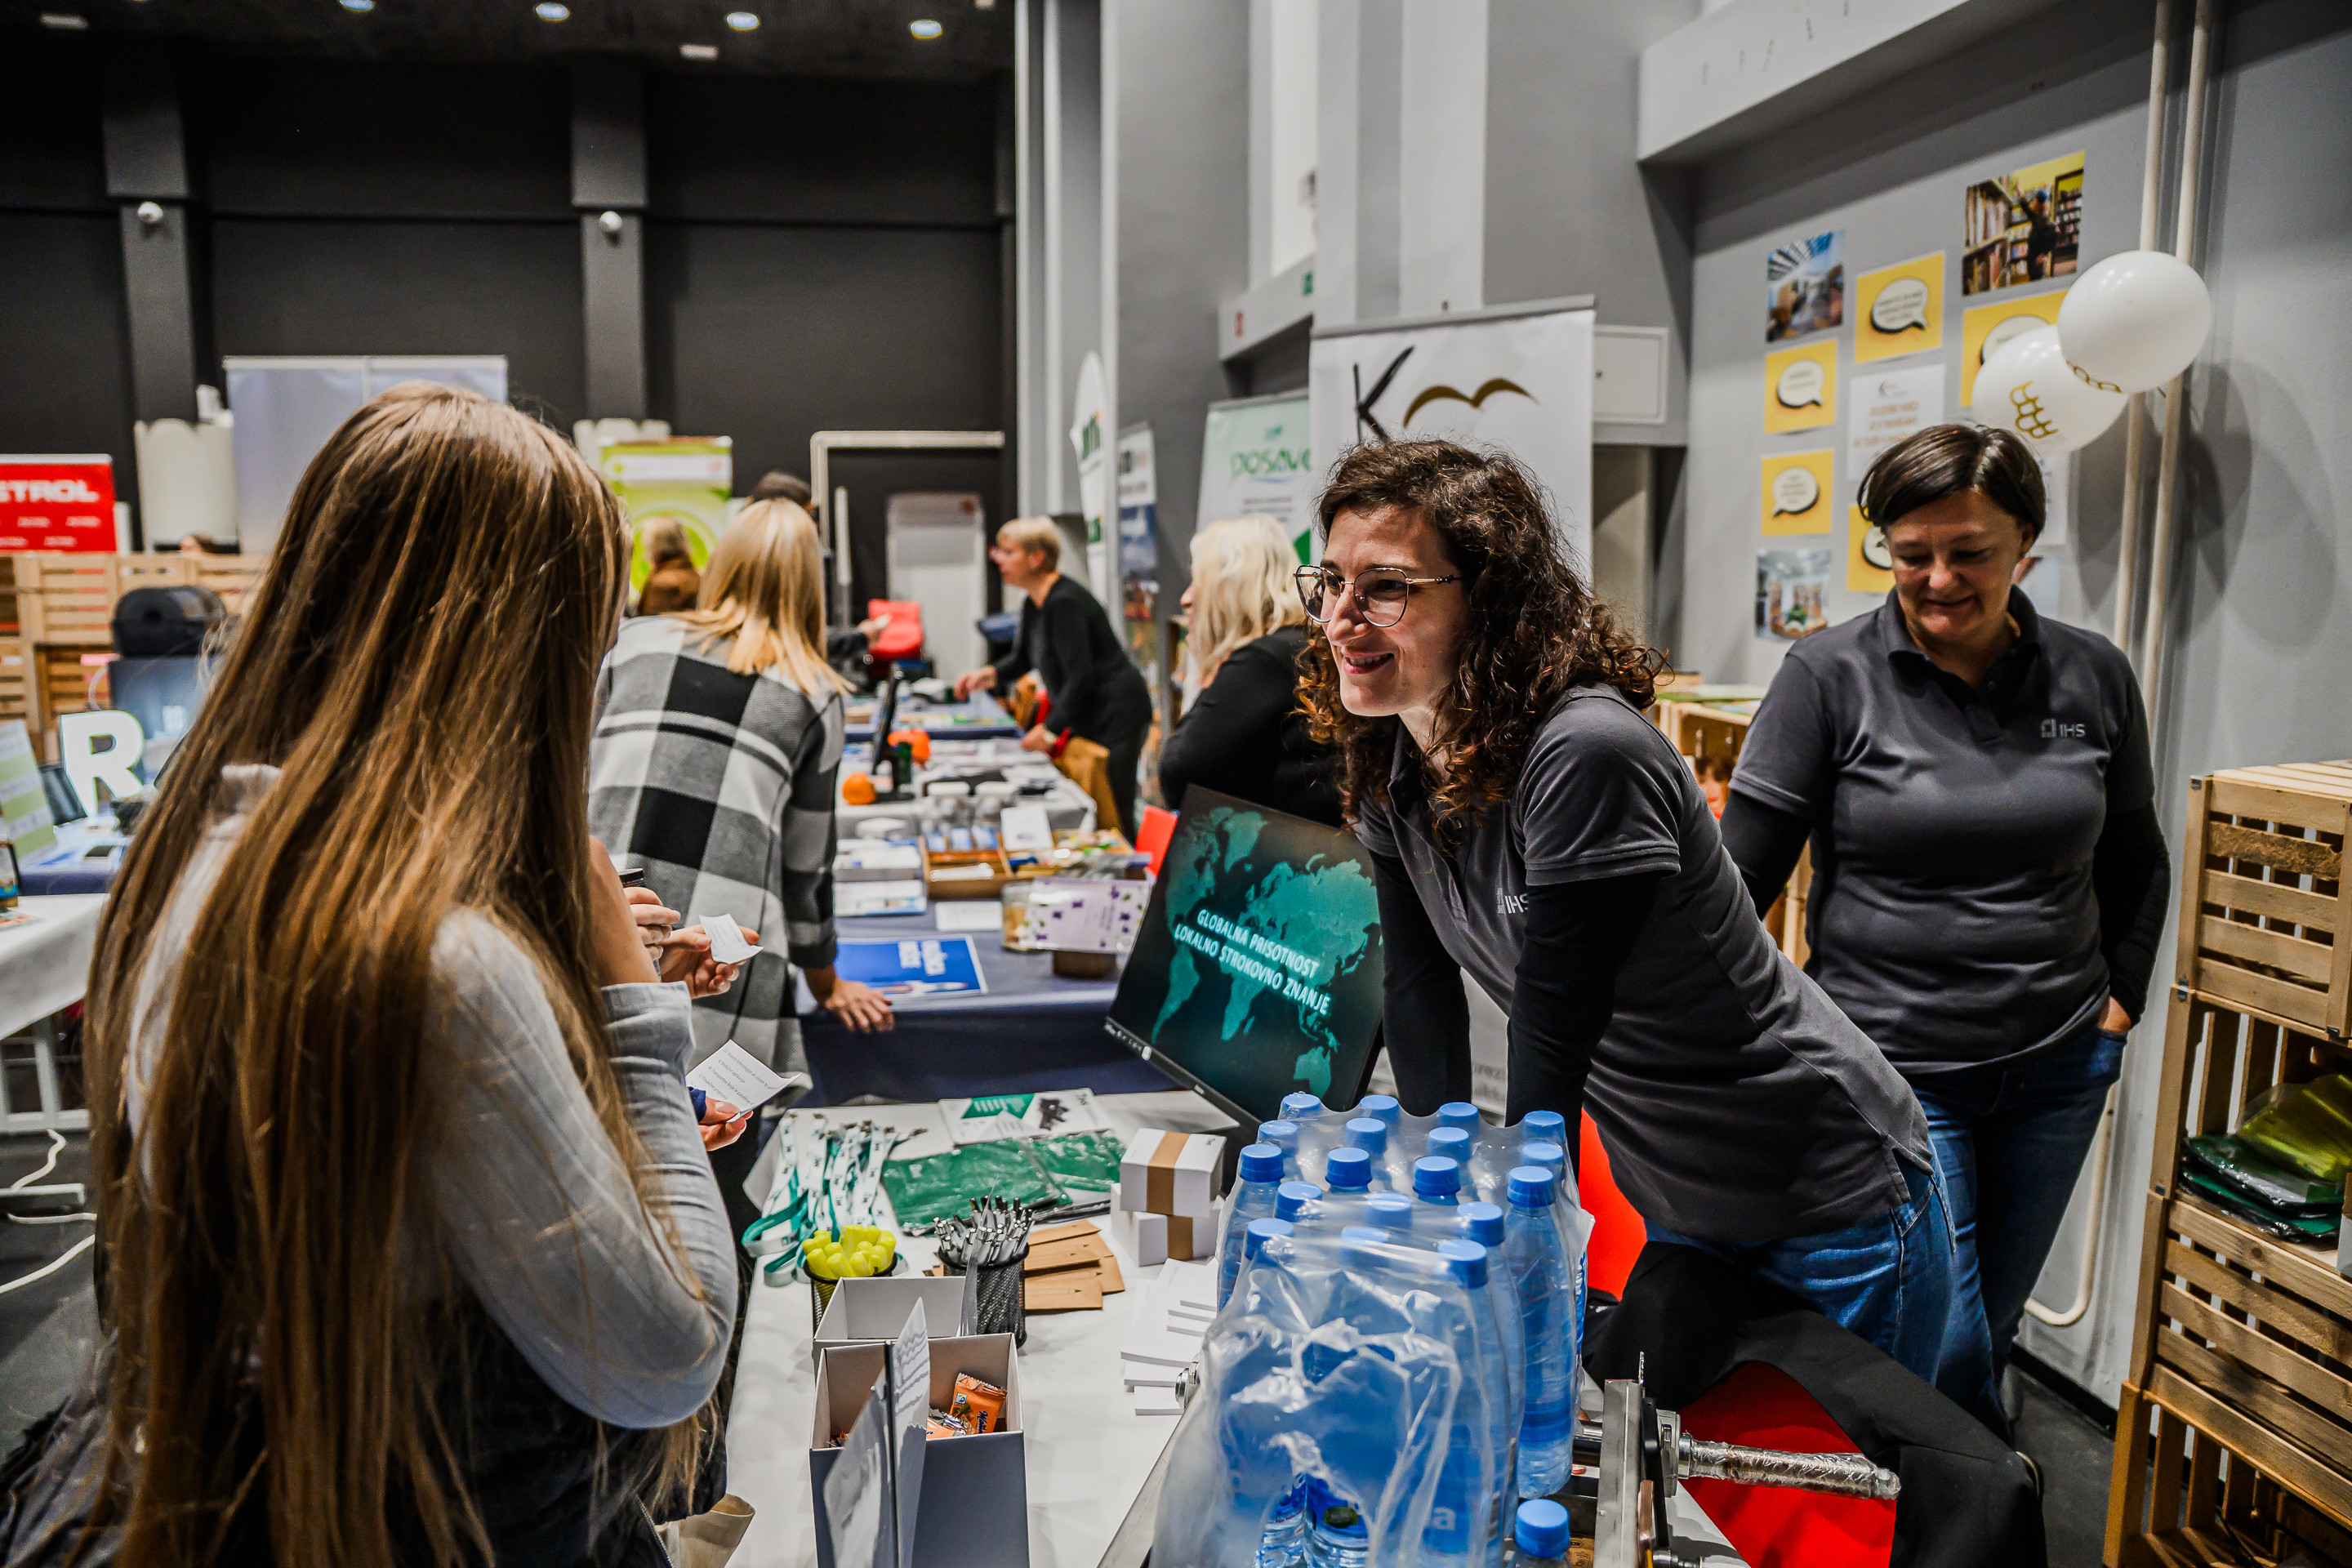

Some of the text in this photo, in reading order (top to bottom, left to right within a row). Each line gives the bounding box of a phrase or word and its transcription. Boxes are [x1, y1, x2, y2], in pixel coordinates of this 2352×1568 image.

[60, 709, 144, 819] R
[2059, 723, 2086, 737] IHS
[1174, 923, 1331, 1015] LOKALNO STROKOVNO ZNANJE
[1196, 909, 1321, 979] GLOBALNA PRISOTNOST
